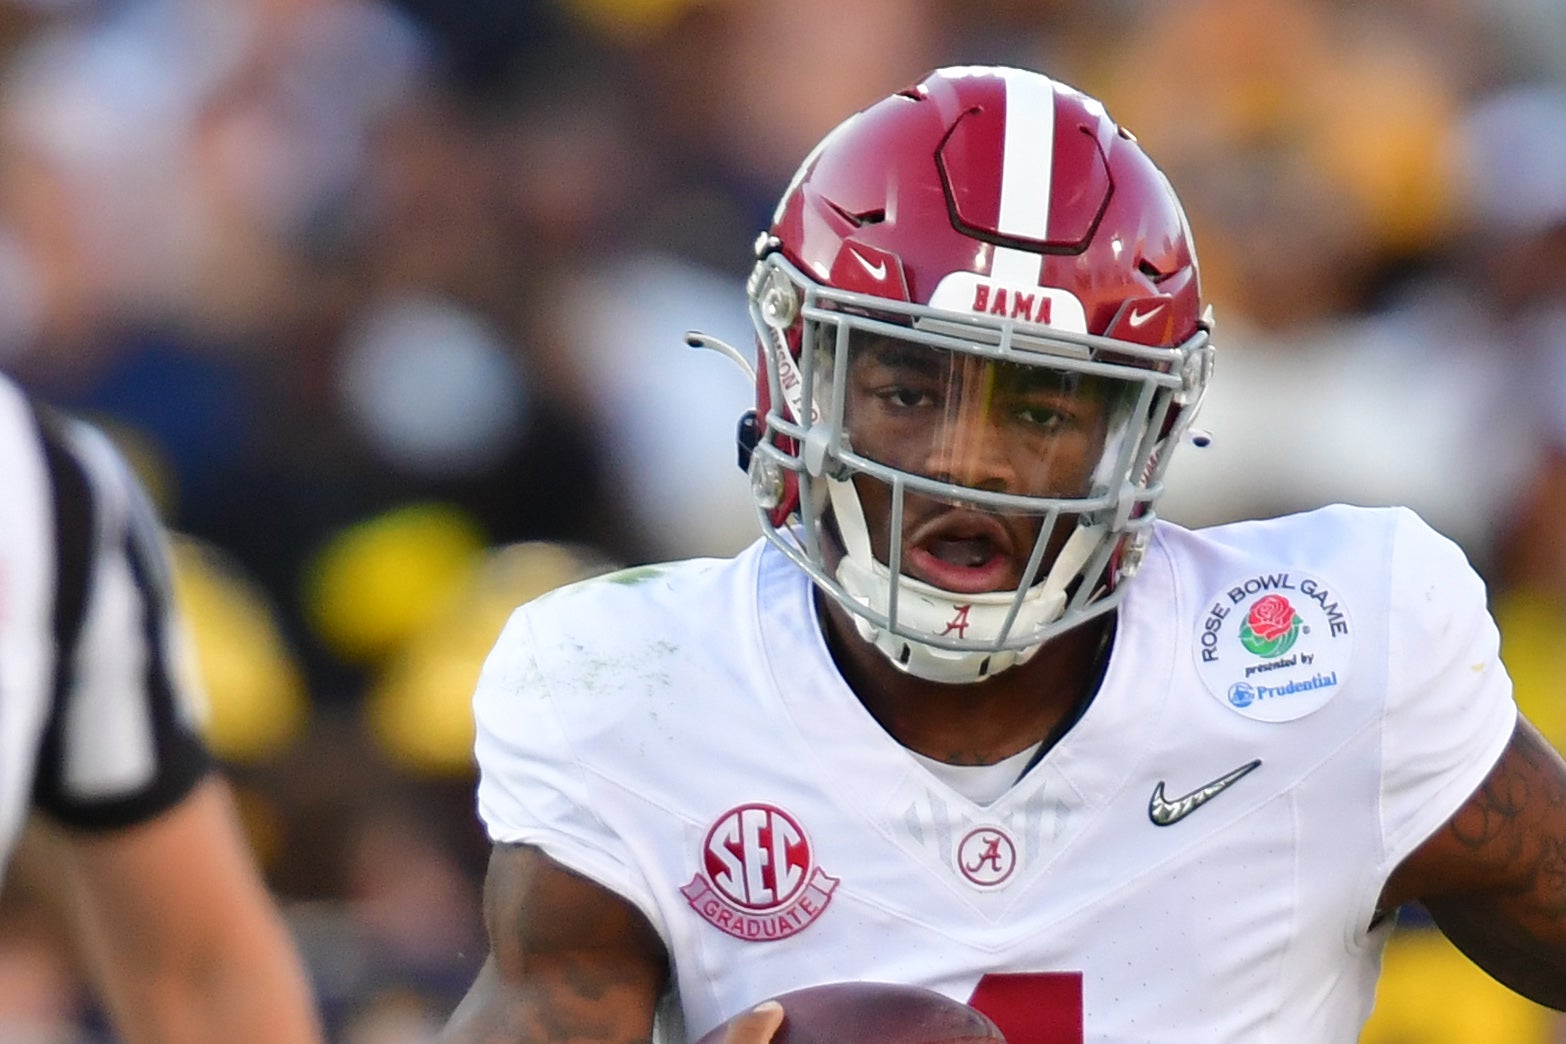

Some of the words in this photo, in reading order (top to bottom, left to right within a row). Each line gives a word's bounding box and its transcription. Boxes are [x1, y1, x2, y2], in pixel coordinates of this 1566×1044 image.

[972, 284, 1052, 325] BAMA
[1202, 603, 1231, 662] ROSE
[1228, 573, 1296, 605] BOWL
[1300, 579, 1348, 637] GAME
[1245, 654, 1297, 678] presented
[1301, 652, 1315, 664] by
[1257, 671, 1337, 700] Prudential
[709, 809, 803, 904] SEC
[703, 896, 820, 937] GRADUATE
